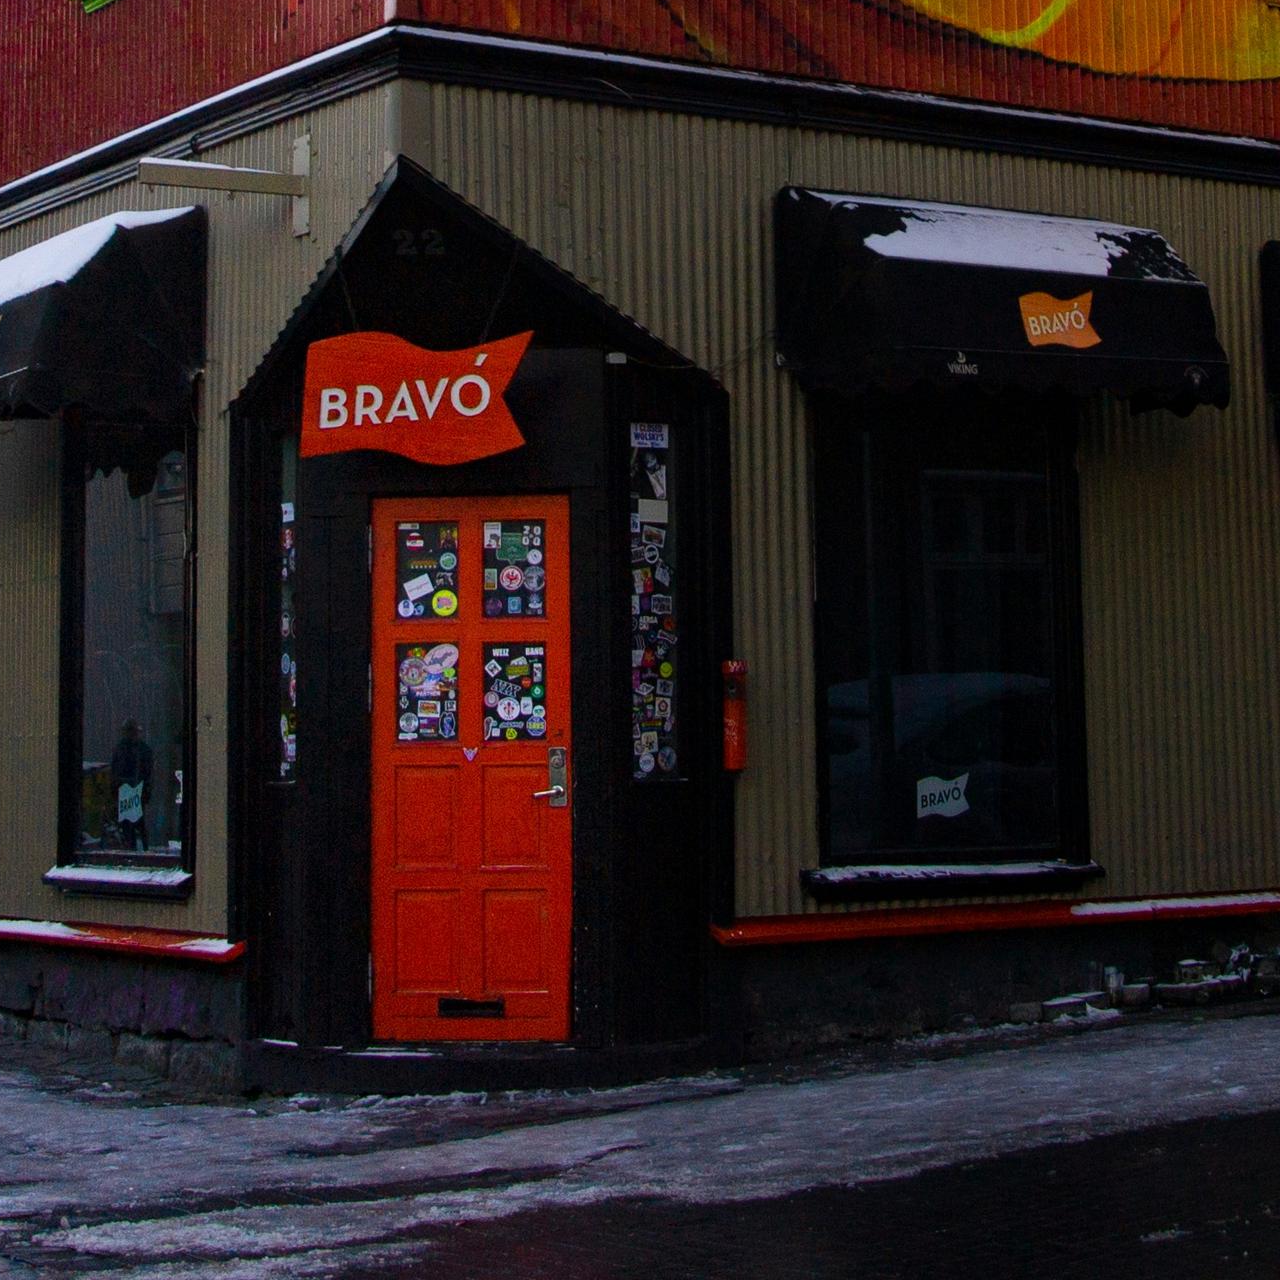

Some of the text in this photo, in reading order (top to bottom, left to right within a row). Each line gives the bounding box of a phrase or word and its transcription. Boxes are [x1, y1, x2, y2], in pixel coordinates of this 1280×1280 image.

[393, 229, 445, 256] 22
[1028, 303, 1086, 337] BRAVÓ
[947, 362, 979, 375] VIKING
[319, 353, 491, 429] BRAVÓ
[921, 782, 961, 808] BRAVÓ
